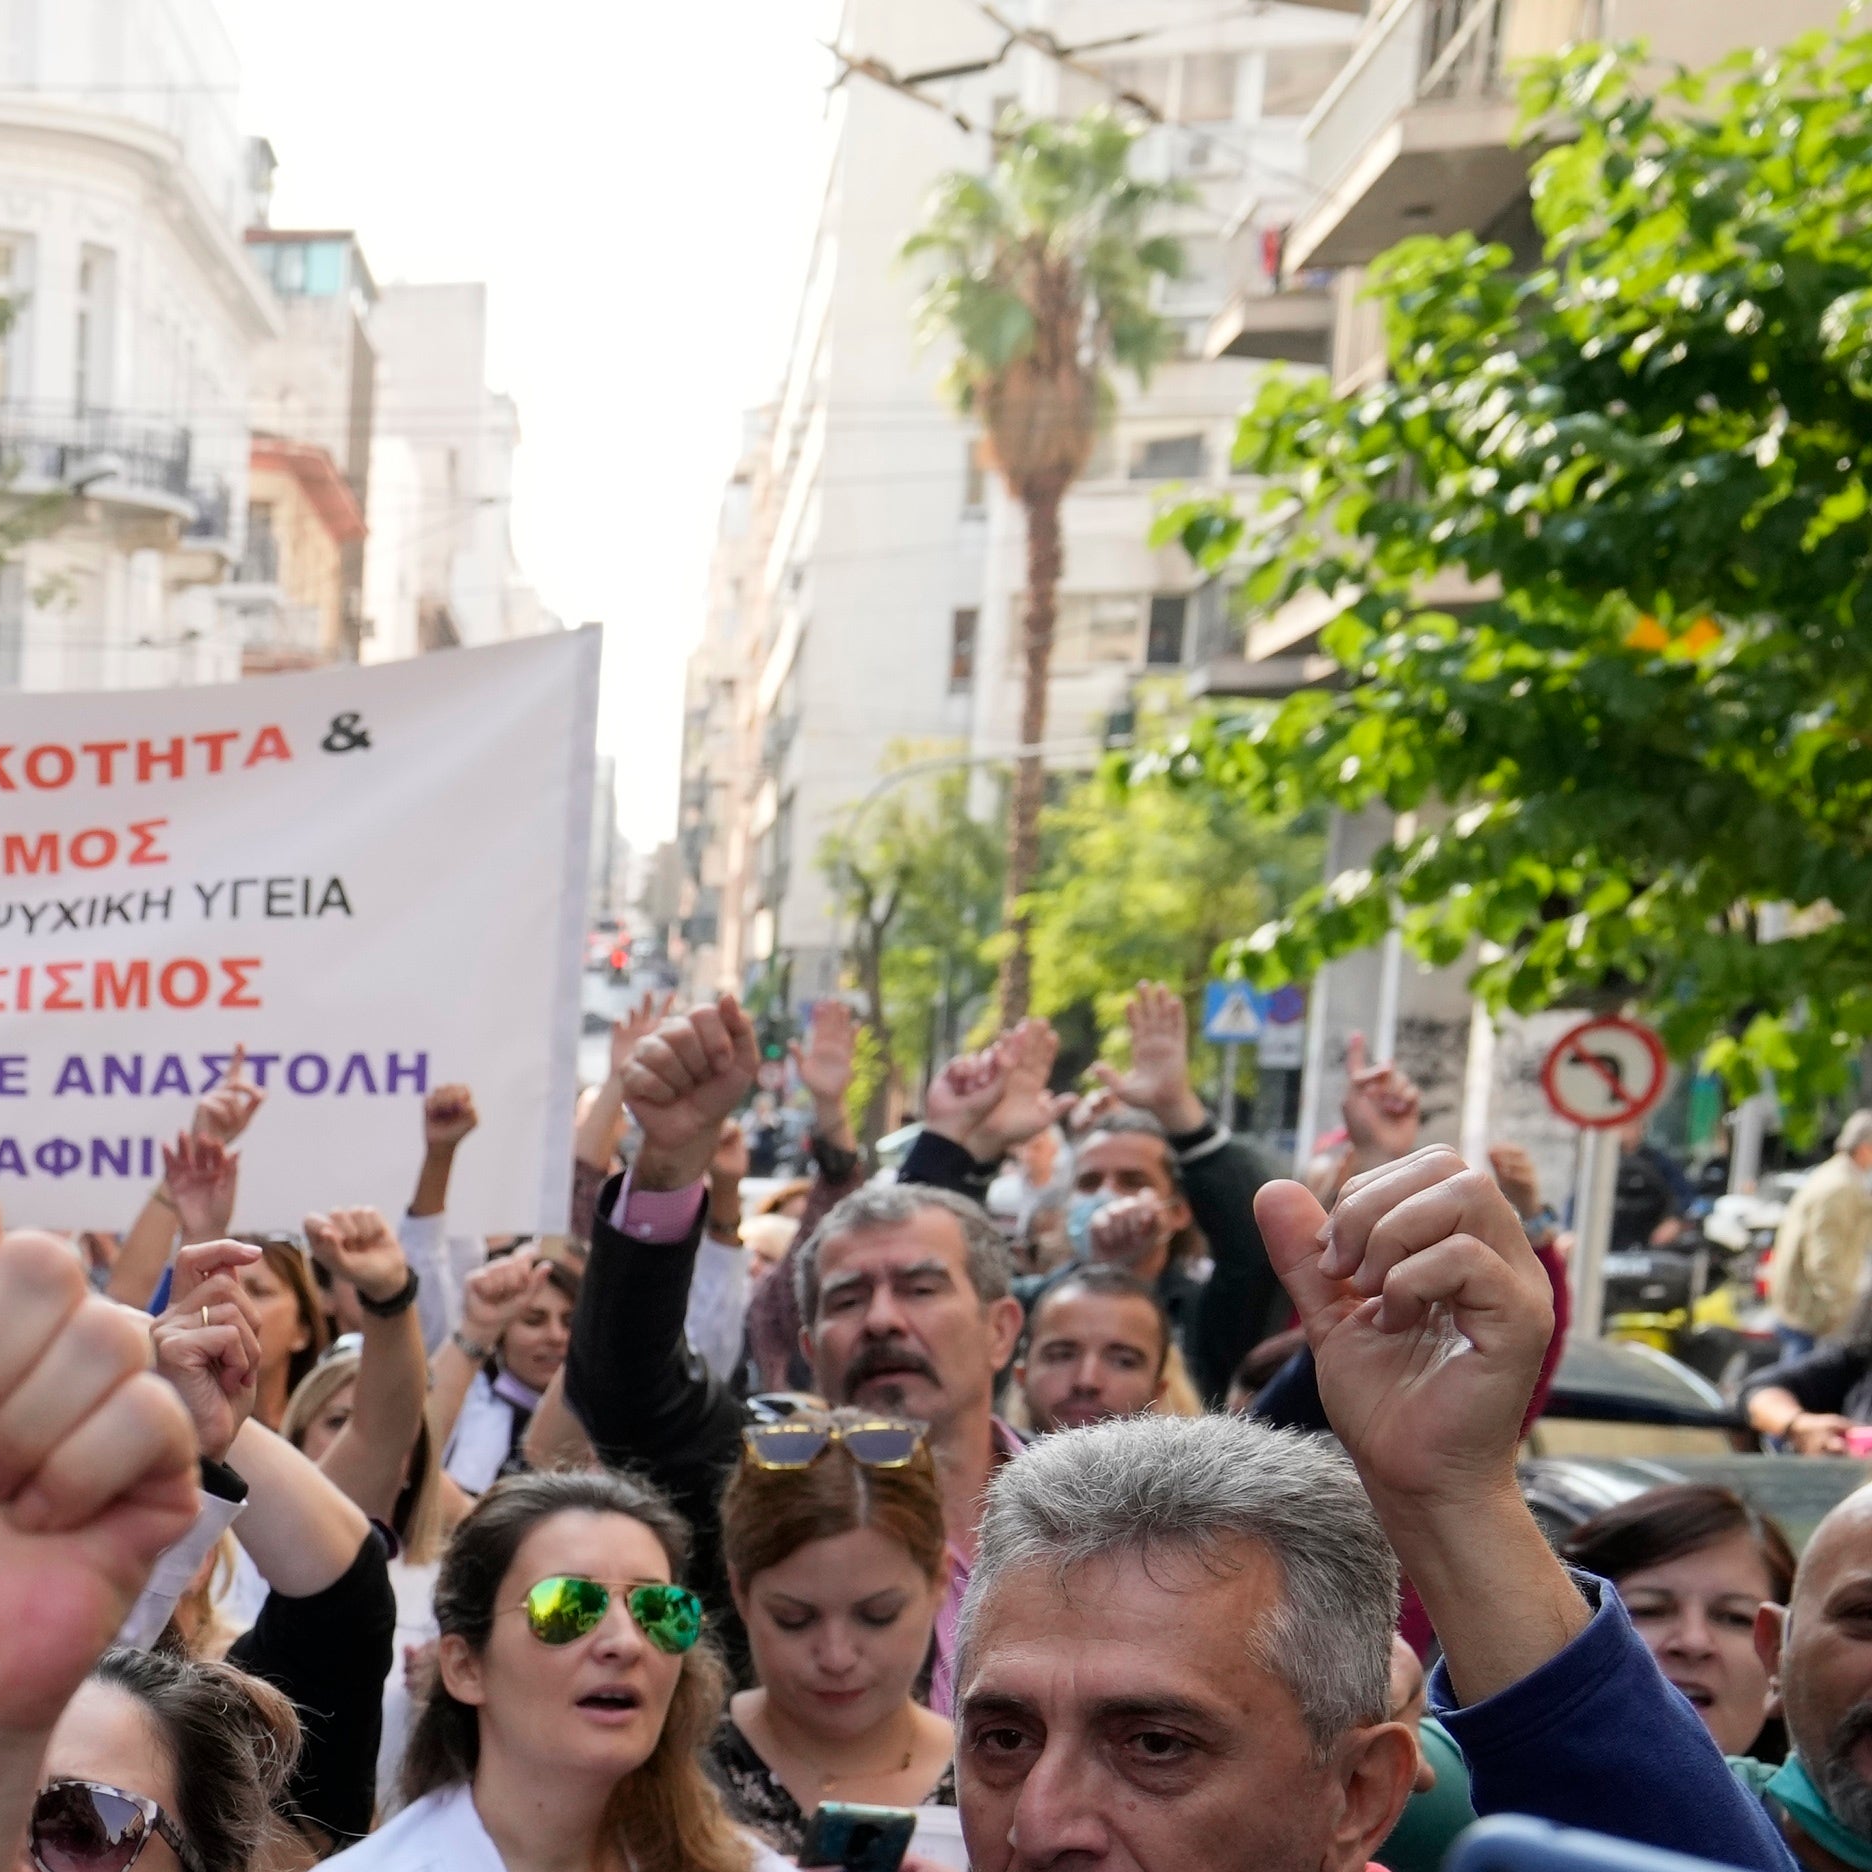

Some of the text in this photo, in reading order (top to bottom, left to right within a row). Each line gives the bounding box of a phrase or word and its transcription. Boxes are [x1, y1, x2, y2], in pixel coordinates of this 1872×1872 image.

[321, 711, 372, 754] &
[193, 874, 354, 921] ΥΓΕΙΑ
[54, 1050, 429, 1098] ΑΝΑΣΤΟΛΗ
